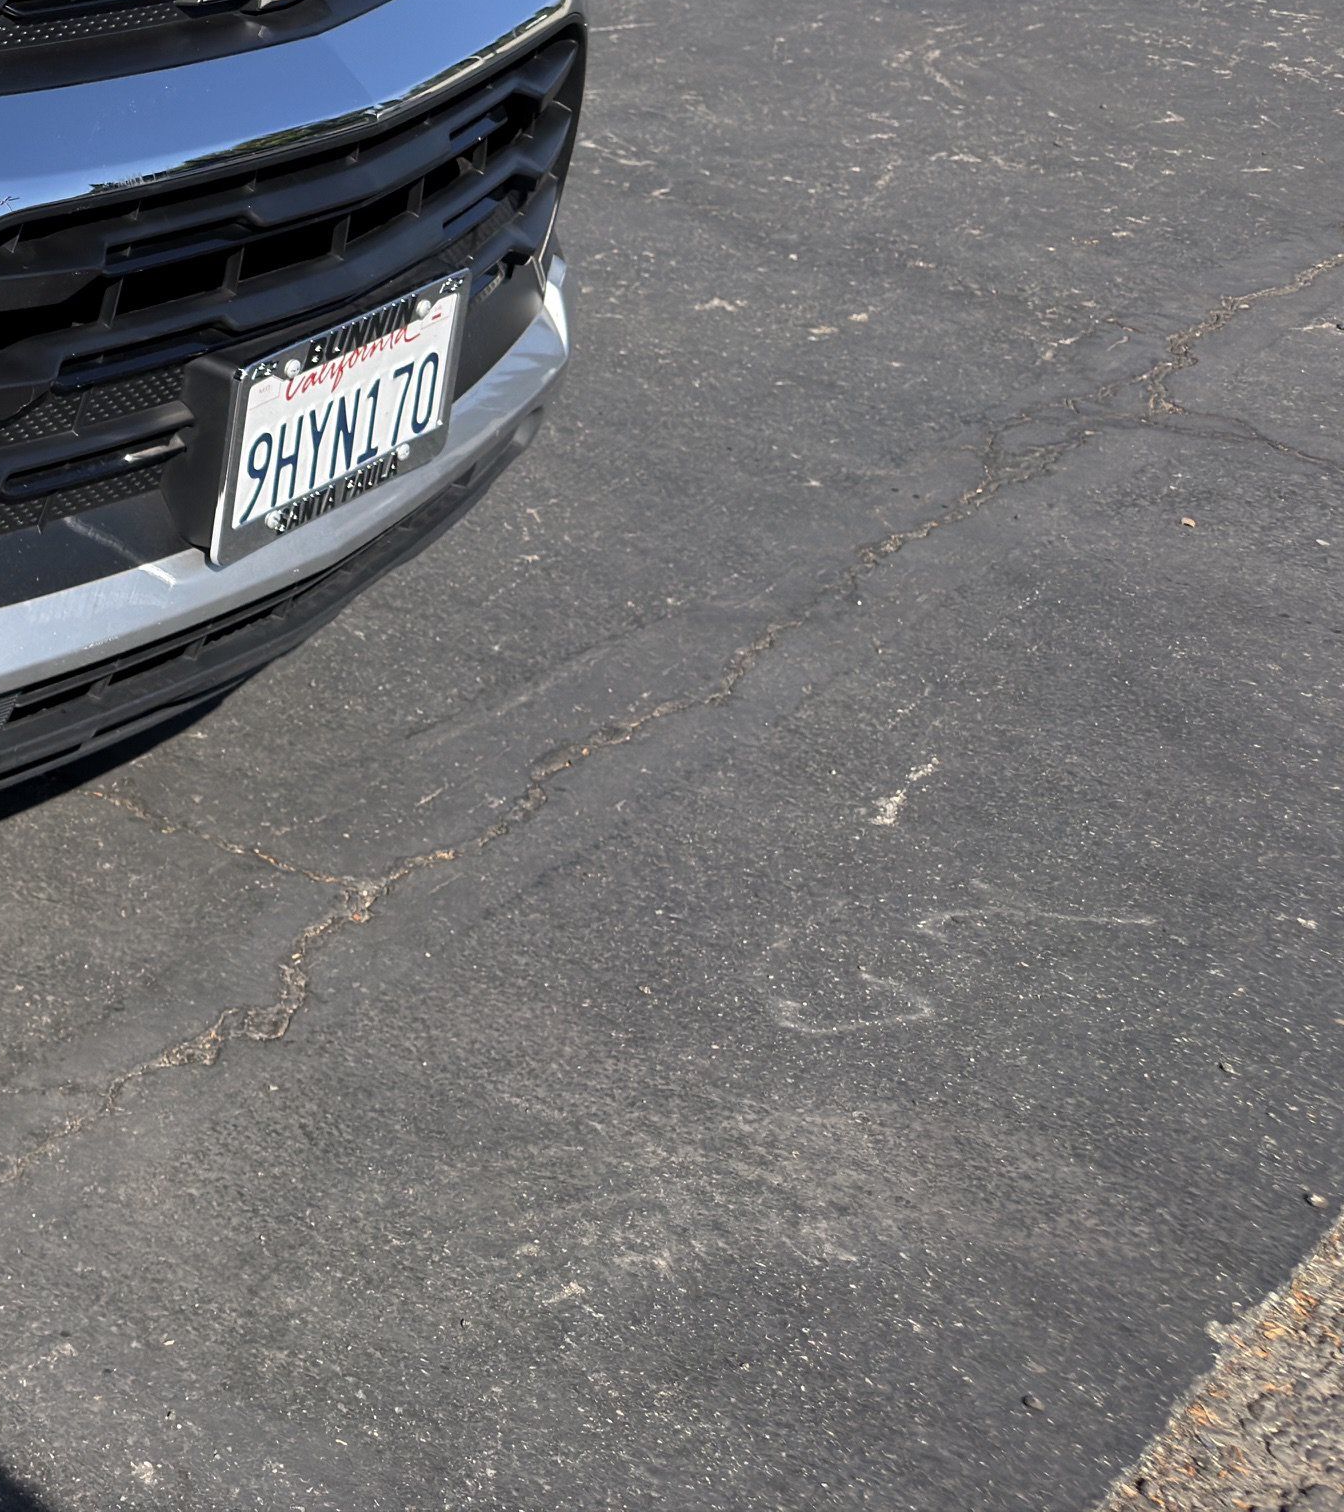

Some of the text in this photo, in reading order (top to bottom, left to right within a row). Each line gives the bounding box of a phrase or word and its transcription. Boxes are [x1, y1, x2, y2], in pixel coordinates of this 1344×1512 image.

[285, 324, 421, 401] California
[302, 294, 416, 374] BUNNIN
[238, 351, 440, 524] 9HYN170
[340, 451, 399, 503] PAULA
